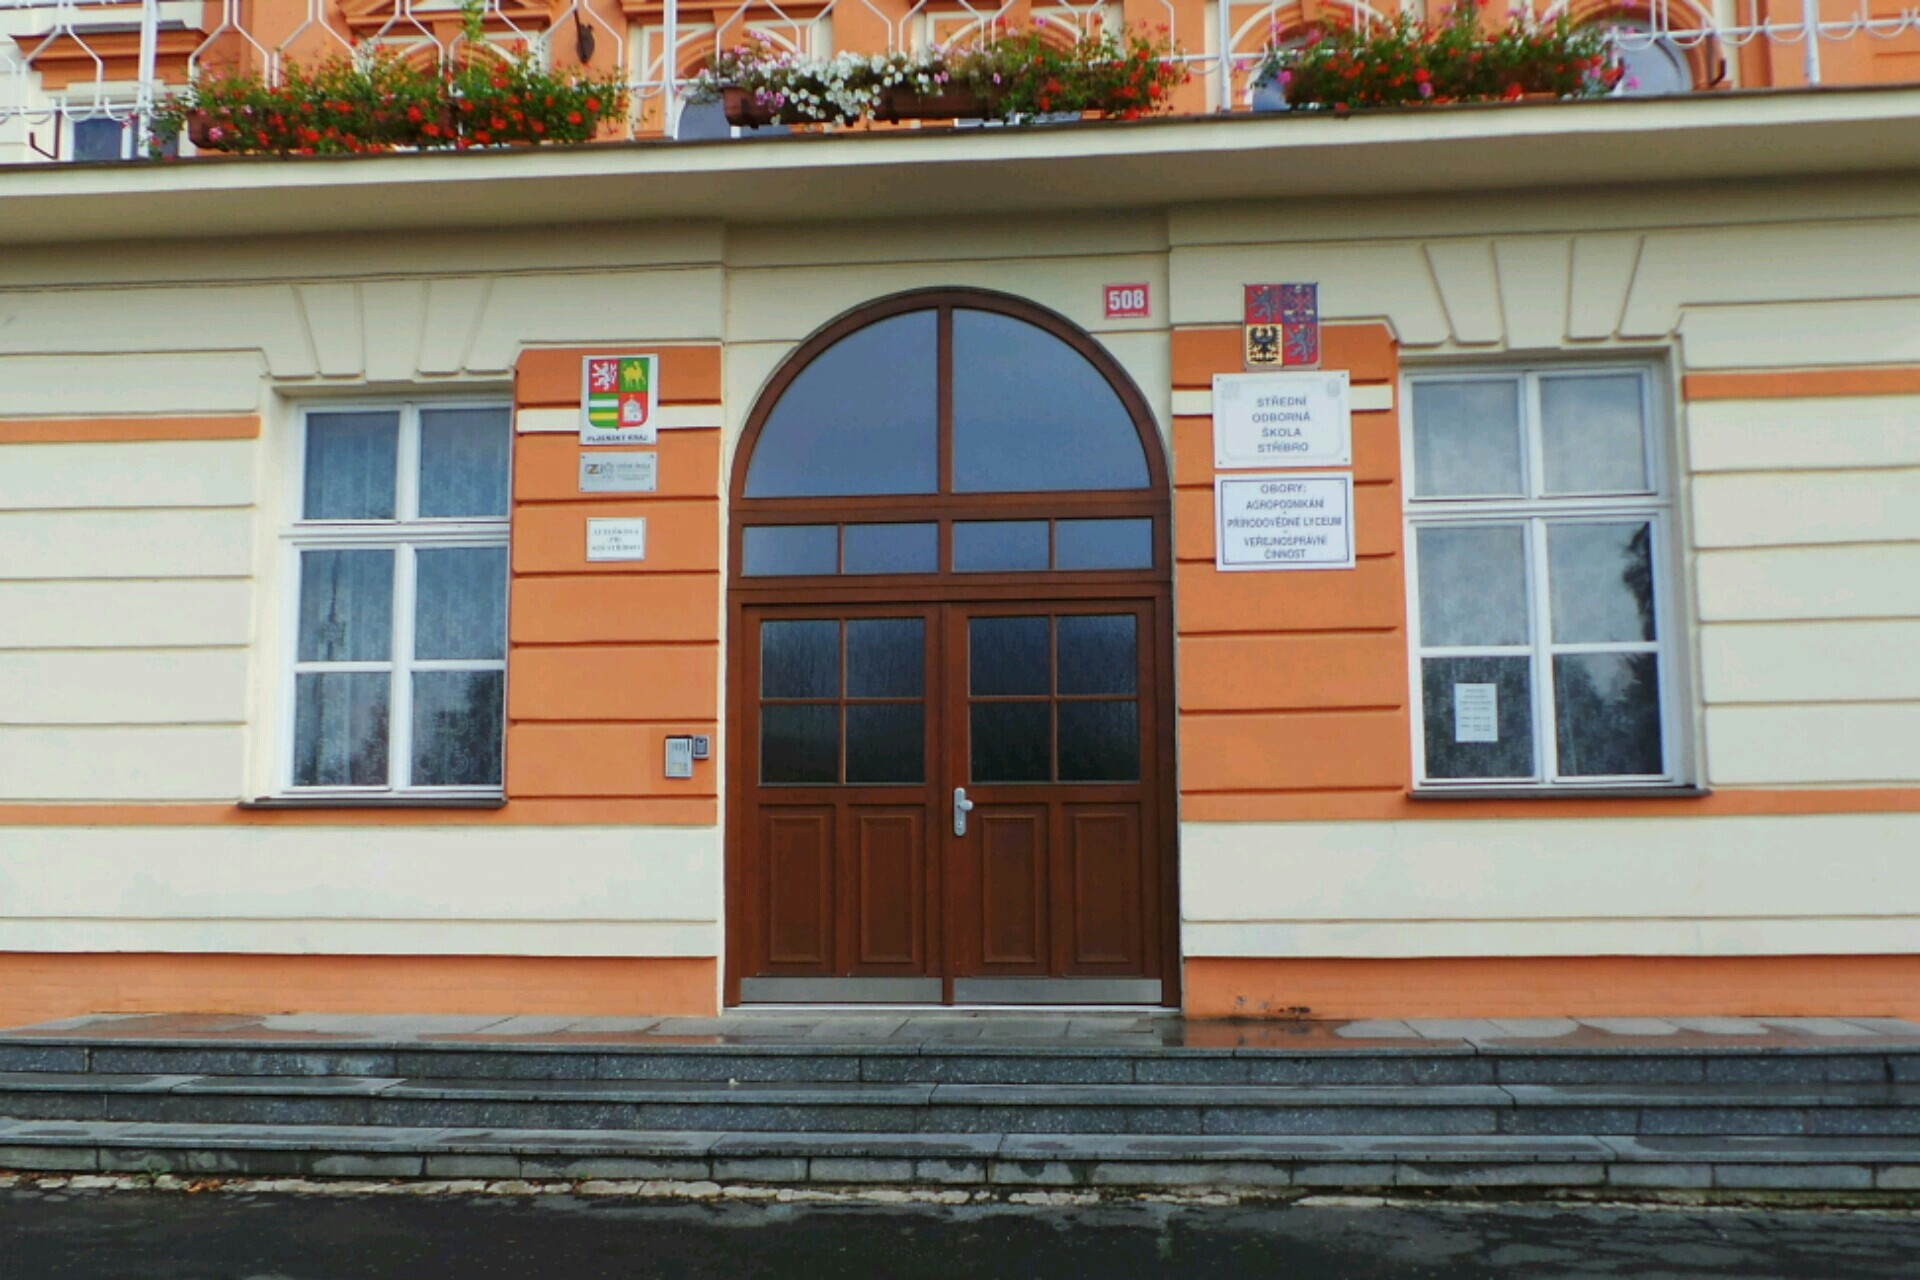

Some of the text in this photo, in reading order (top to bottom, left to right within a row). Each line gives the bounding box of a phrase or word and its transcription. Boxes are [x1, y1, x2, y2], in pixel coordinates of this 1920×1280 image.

[1109, 288, 1145, 311] 508
[1256, 394, 1307, 408] STŘEDNÍ
[1251, 410, 1311, 424] ODBORNÁ
[1261, 426, 1302, 438] ŠKOLA
[1260, 483, 1307, 494] OBORY:
[1303, 515, 1342, 527] LYCEUM
